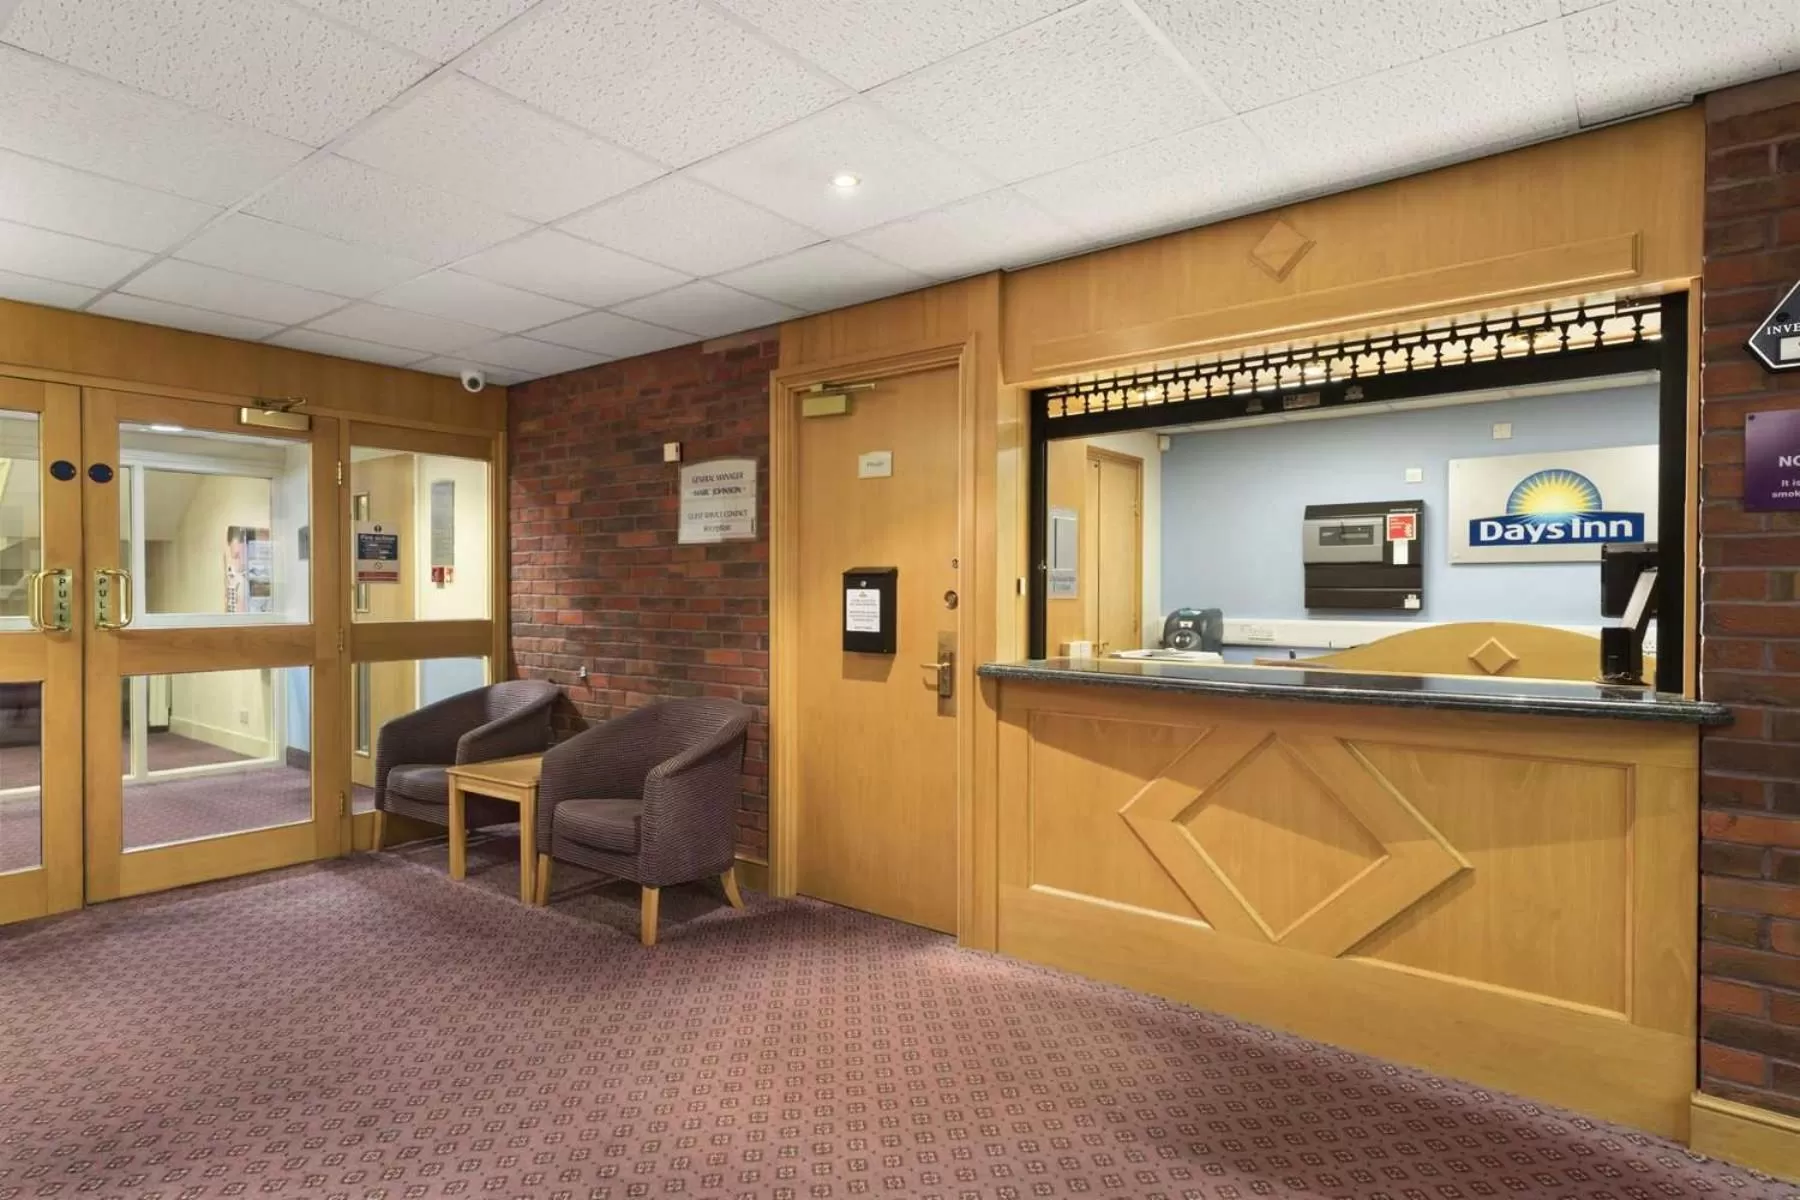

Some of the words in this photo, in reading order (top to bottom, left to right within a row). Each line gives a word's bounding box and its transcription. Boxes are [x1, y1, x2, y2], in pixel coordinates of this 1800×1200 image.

[715, 471, 744, 481] MANAGER
[1781, 479, 1789, 488] It
[1479, 520, 1565, 543] Days
[1571, 518, 1633, 539] Inn
[59, 578, 67, 622] PULL
[98, 577, 107, 621] PULL
